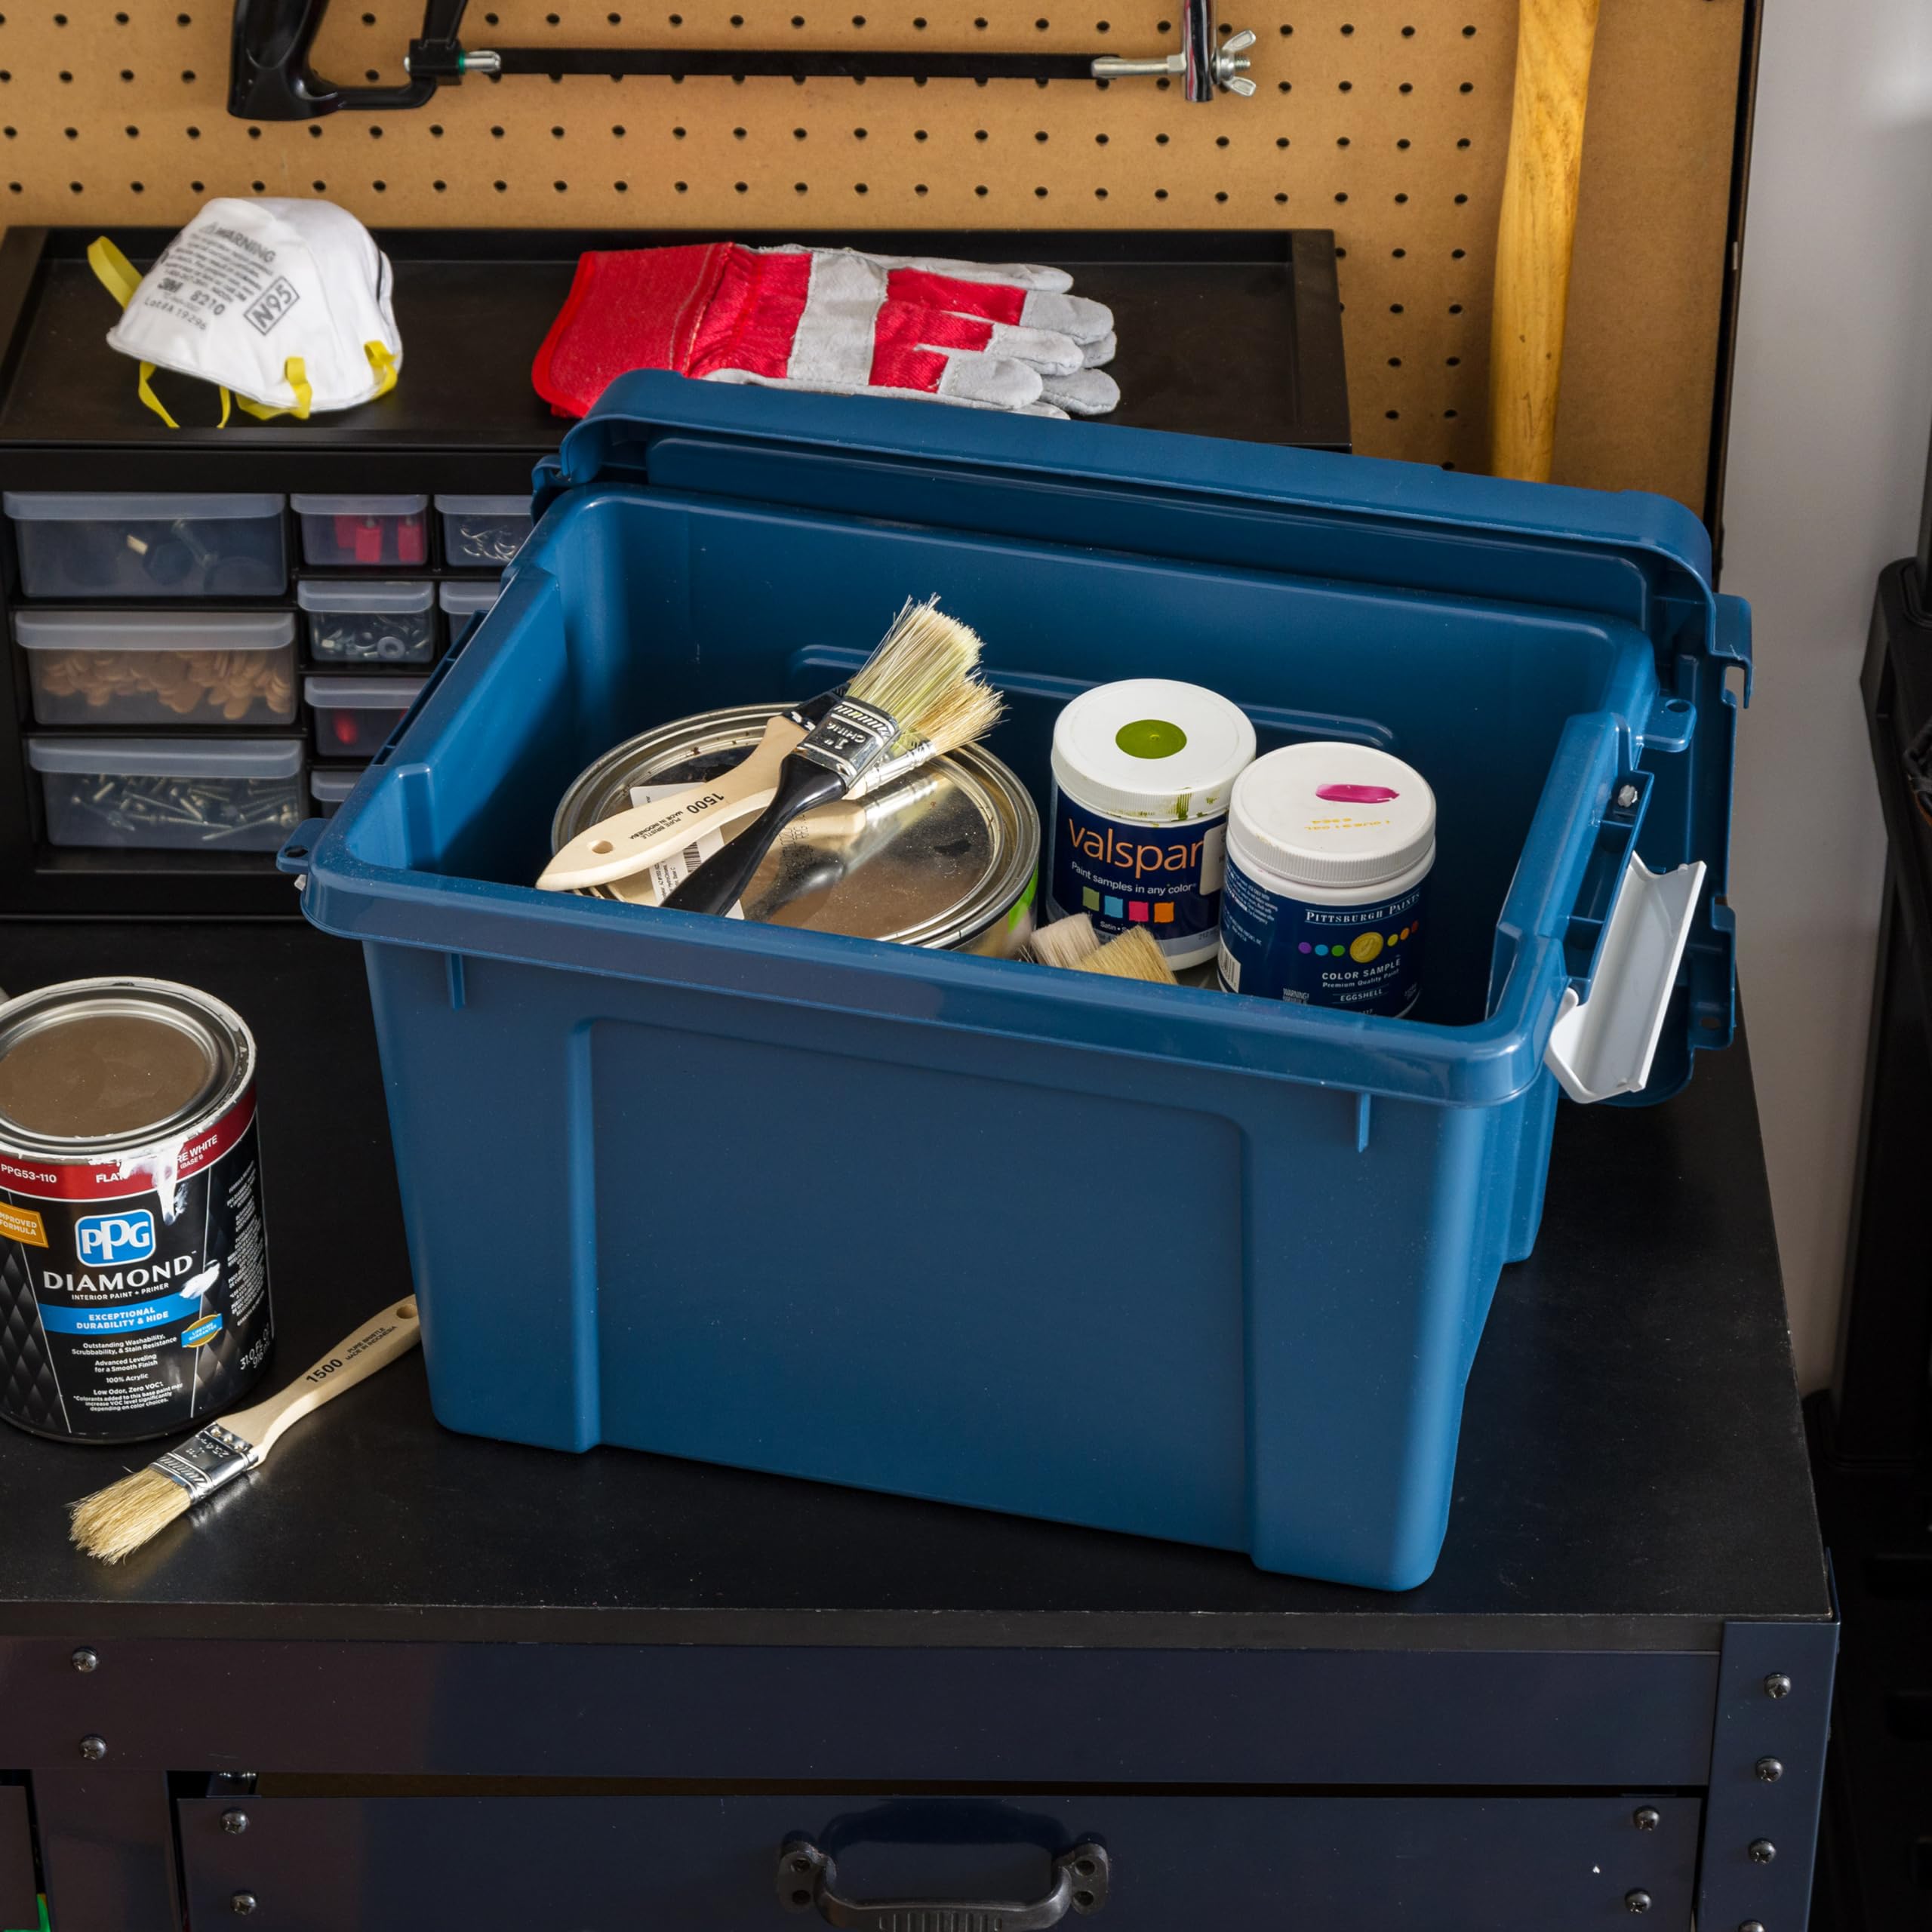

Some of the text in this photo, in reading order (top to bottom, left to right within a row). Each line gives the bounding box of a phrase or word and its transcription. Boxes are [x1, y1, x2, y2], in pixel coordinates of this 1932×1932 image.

[216, 228, 276, 263] WARNING
[190, 290, 226, 315] 8210
[252, 285, 293, 330] N95
[686, 792, 724, 814] 1500
[666, 810, 684, 820] MADE
[640, 817, 681, 839] PURE BRISTLE
[1069, 818, 1204, 879] valspar
[1071, 861, 1091, 879] Paint
[1093, 874, 1133, 892] samples
[1135, 884, 1145, 894] in
[1147, 886, 1166, 897] any
[1100, 920, 1117, 931] Satin
[1321, 958, 1401, 980] COLOR SAMPLE
[1358, 976, 1382, 986] Quality
[1383, 968, 1400, 979] Paint
[1282, 987, 1310, 999] WARNING!
[1340, 989, 1383, 1001] EGGSHELL
[176, 1134, 218, 1163] RE WHITE
[180, 1156, 198, 1169] (BASE
[1, 1164, 57, 1183] PPG53-110
[0, 1212, 37, 1229] MPROVED
[81, 1219, 149, 1260] PPG
[43, 1255, 193, 1291] DIAMOND
[109, 1291, 133, 1300] PAINT
[141, 1282, 169, 1295] PRIMER
[76, 1318, 136, 1329] DURABILITY
[146, 1311, 169, 1324] HIDE
[88, 1307, 155, 1321] EXCEPTIONAL
[83, 1341, 124, 1349] Outstanding
[125, 1345, 142, 1353] Stain
[143, 1337, 177, 1350] Resistance
[347, 1327, 386, 1353] PURE BRISTLE
[129, 1354, 157, 1364] Leveling
[345, 1349, 362, 1360] MADE
[111, 1364, 137, 1372] Smooth
[138, 1359, 158, 1369] Finish
[306, 1358, 343, 1383] 1500
[138, 1392, 172, 1403] significantly
[156, 1386, 171, 1395] paint
